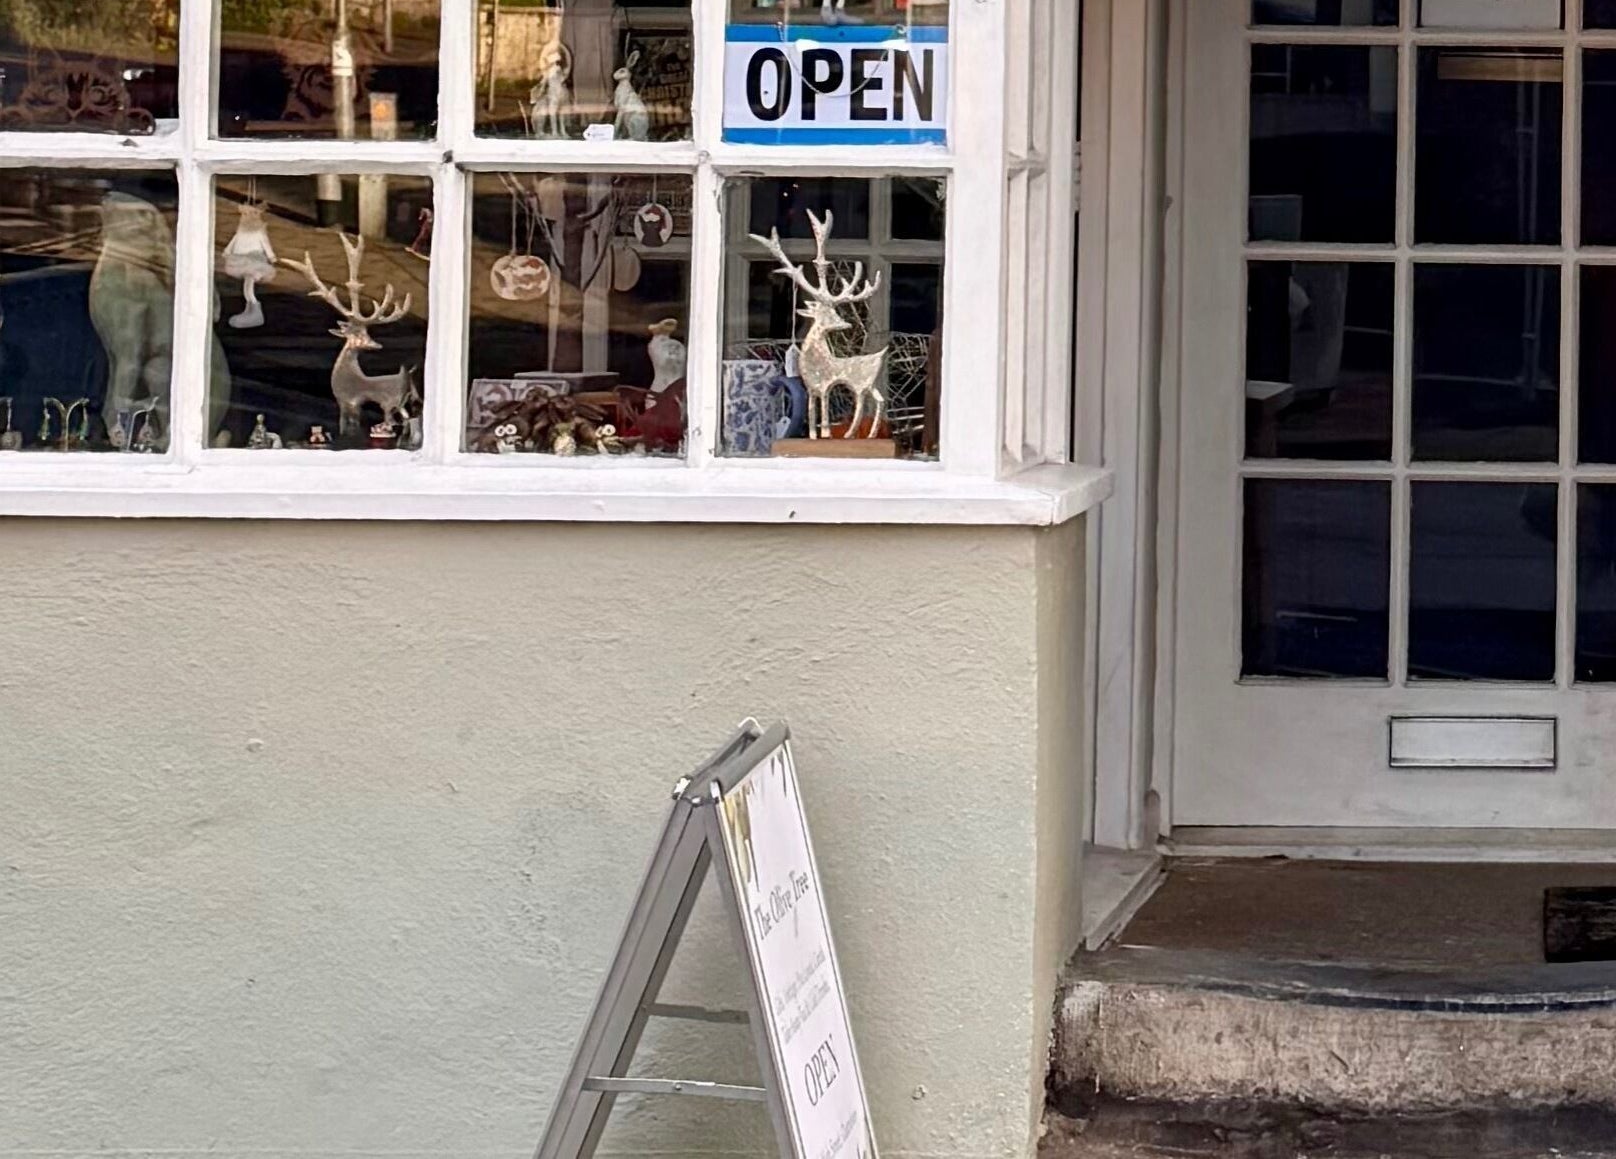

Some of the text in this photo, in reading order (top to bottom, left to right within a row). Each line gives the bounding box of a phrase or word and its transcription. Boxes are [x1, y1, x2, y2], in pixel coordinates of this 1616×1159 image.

[746, 47, 934, 121] OPEN
[754, 869, 809, 941] The Olive Tree
[804, 1033, 840, 1107] OPEN
